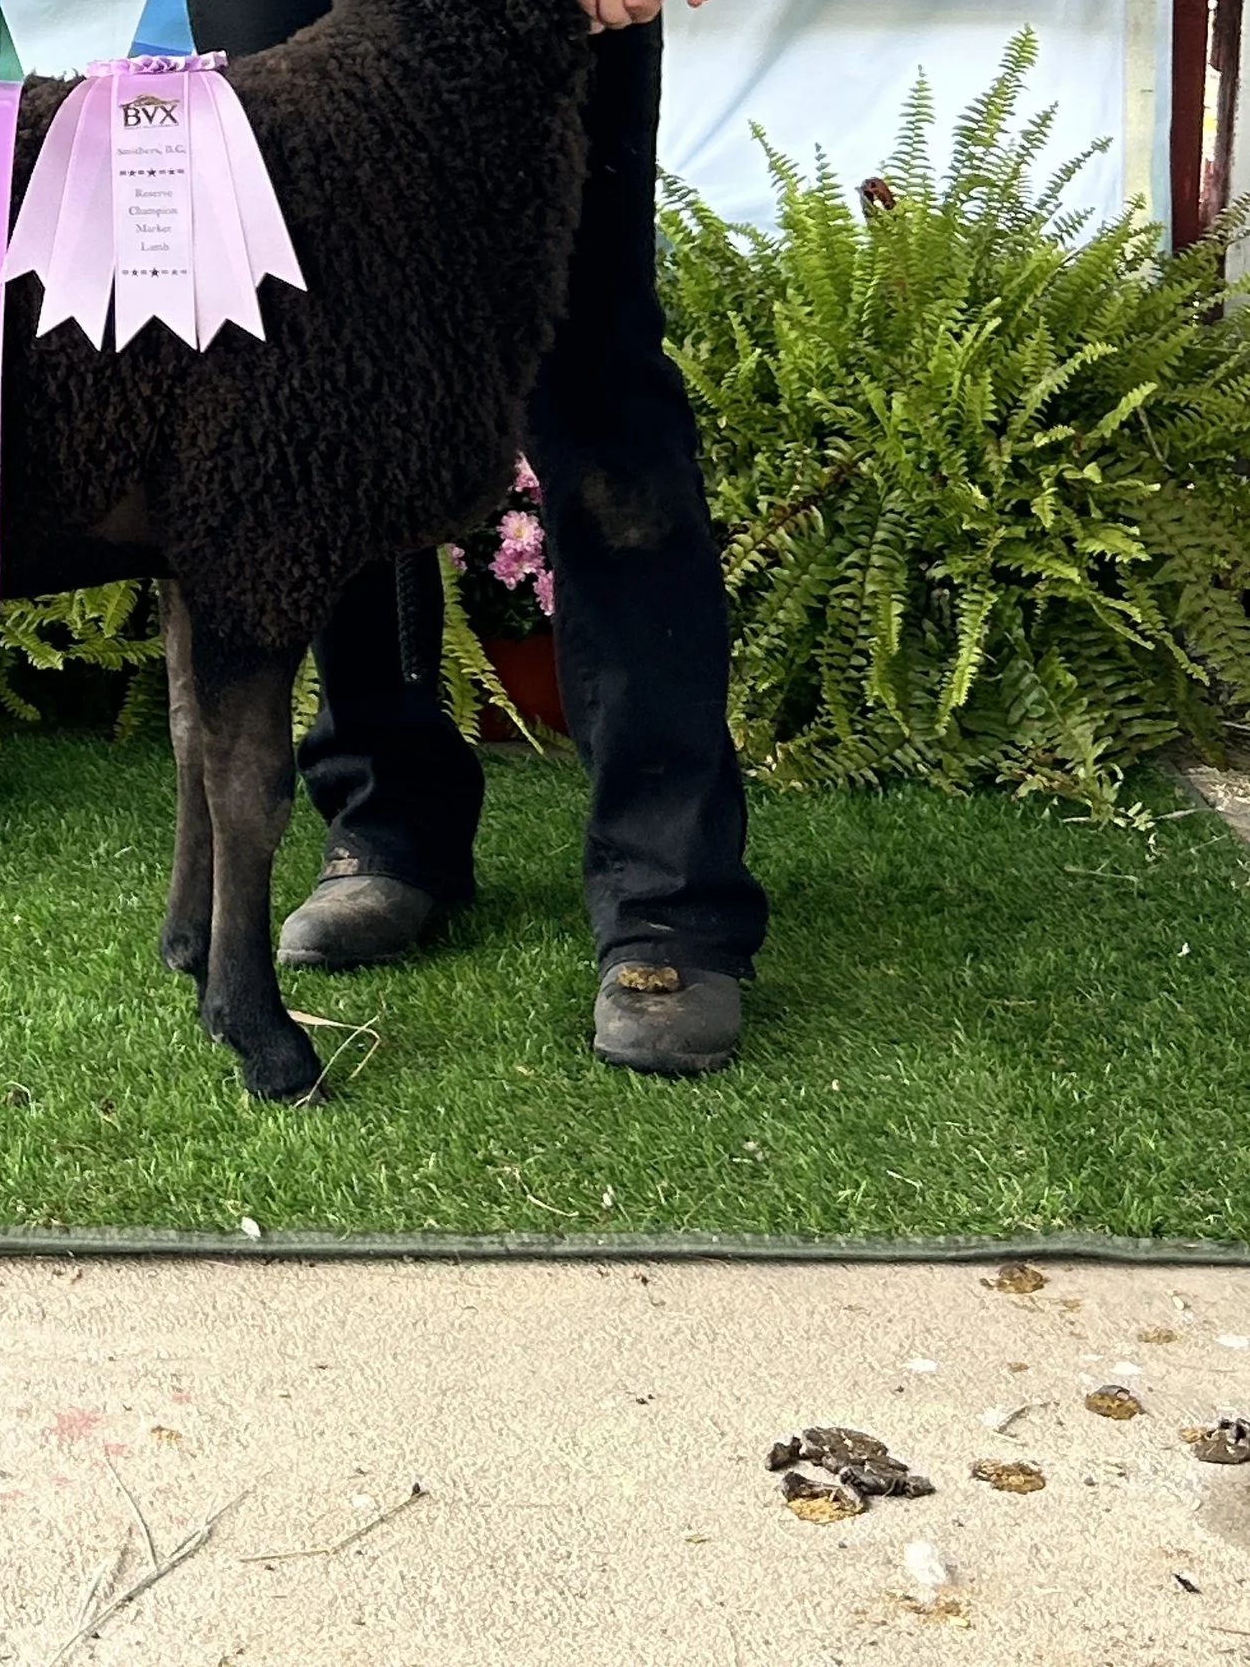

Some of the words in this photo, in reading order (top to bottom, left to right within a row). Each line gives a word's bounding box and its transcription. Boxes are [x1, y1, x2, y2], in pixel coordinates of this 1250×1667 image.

[123, 105, 179, 127] BVX
[135, 188, 172, 198] Reserve
[128, 206, 178, 217] Champion
[135, 223, 172, 233] Market
[140, 242, 170, 252] Lamb
